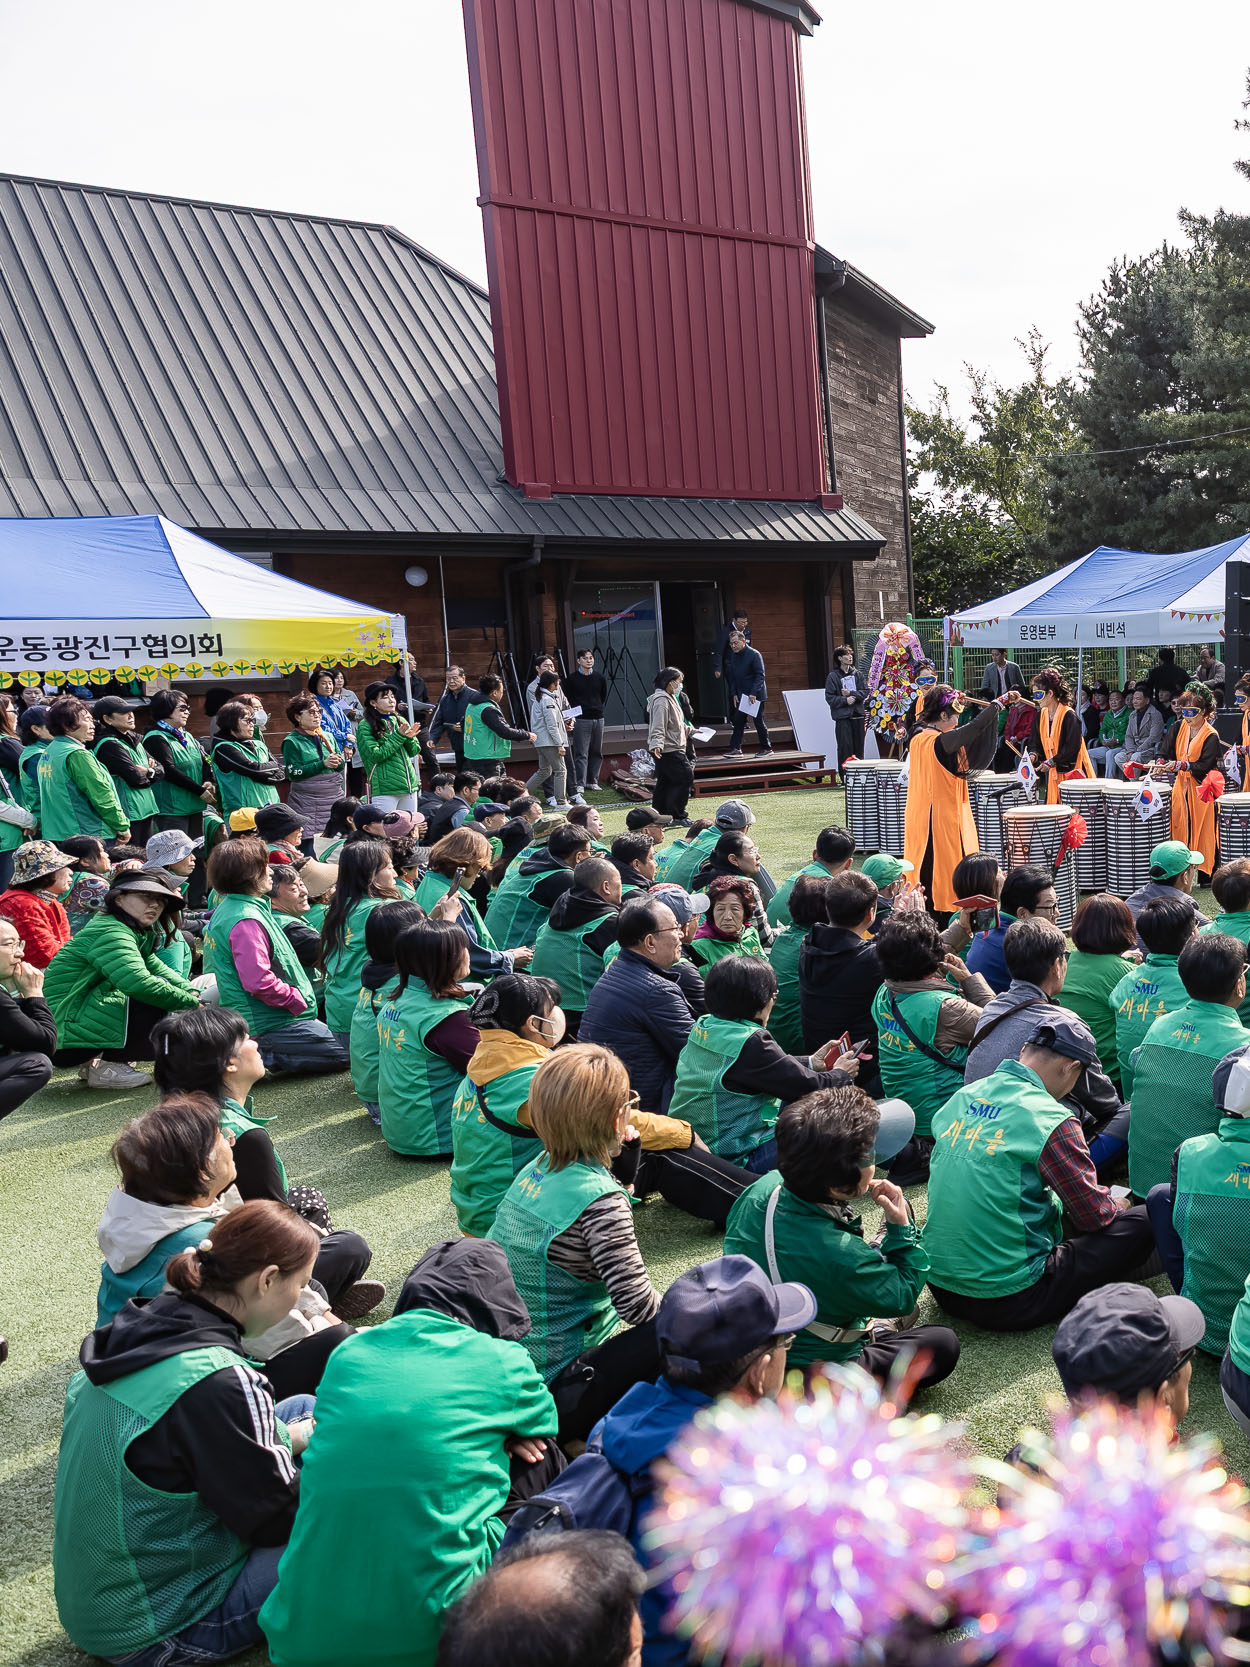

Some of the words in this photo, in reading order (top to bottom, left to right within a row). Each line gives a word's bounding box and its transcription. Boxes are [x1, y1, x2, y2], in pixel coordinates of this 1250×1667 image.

[1019, 623, 1057, 641] 운영본부
[1095, 621, 1127, 639] 내빈석
[1131, 982, 1159, 995] SMU
[966, 1101, 1002, 1119] SMU
[940, 1119, 1006, 1156] 새마을
